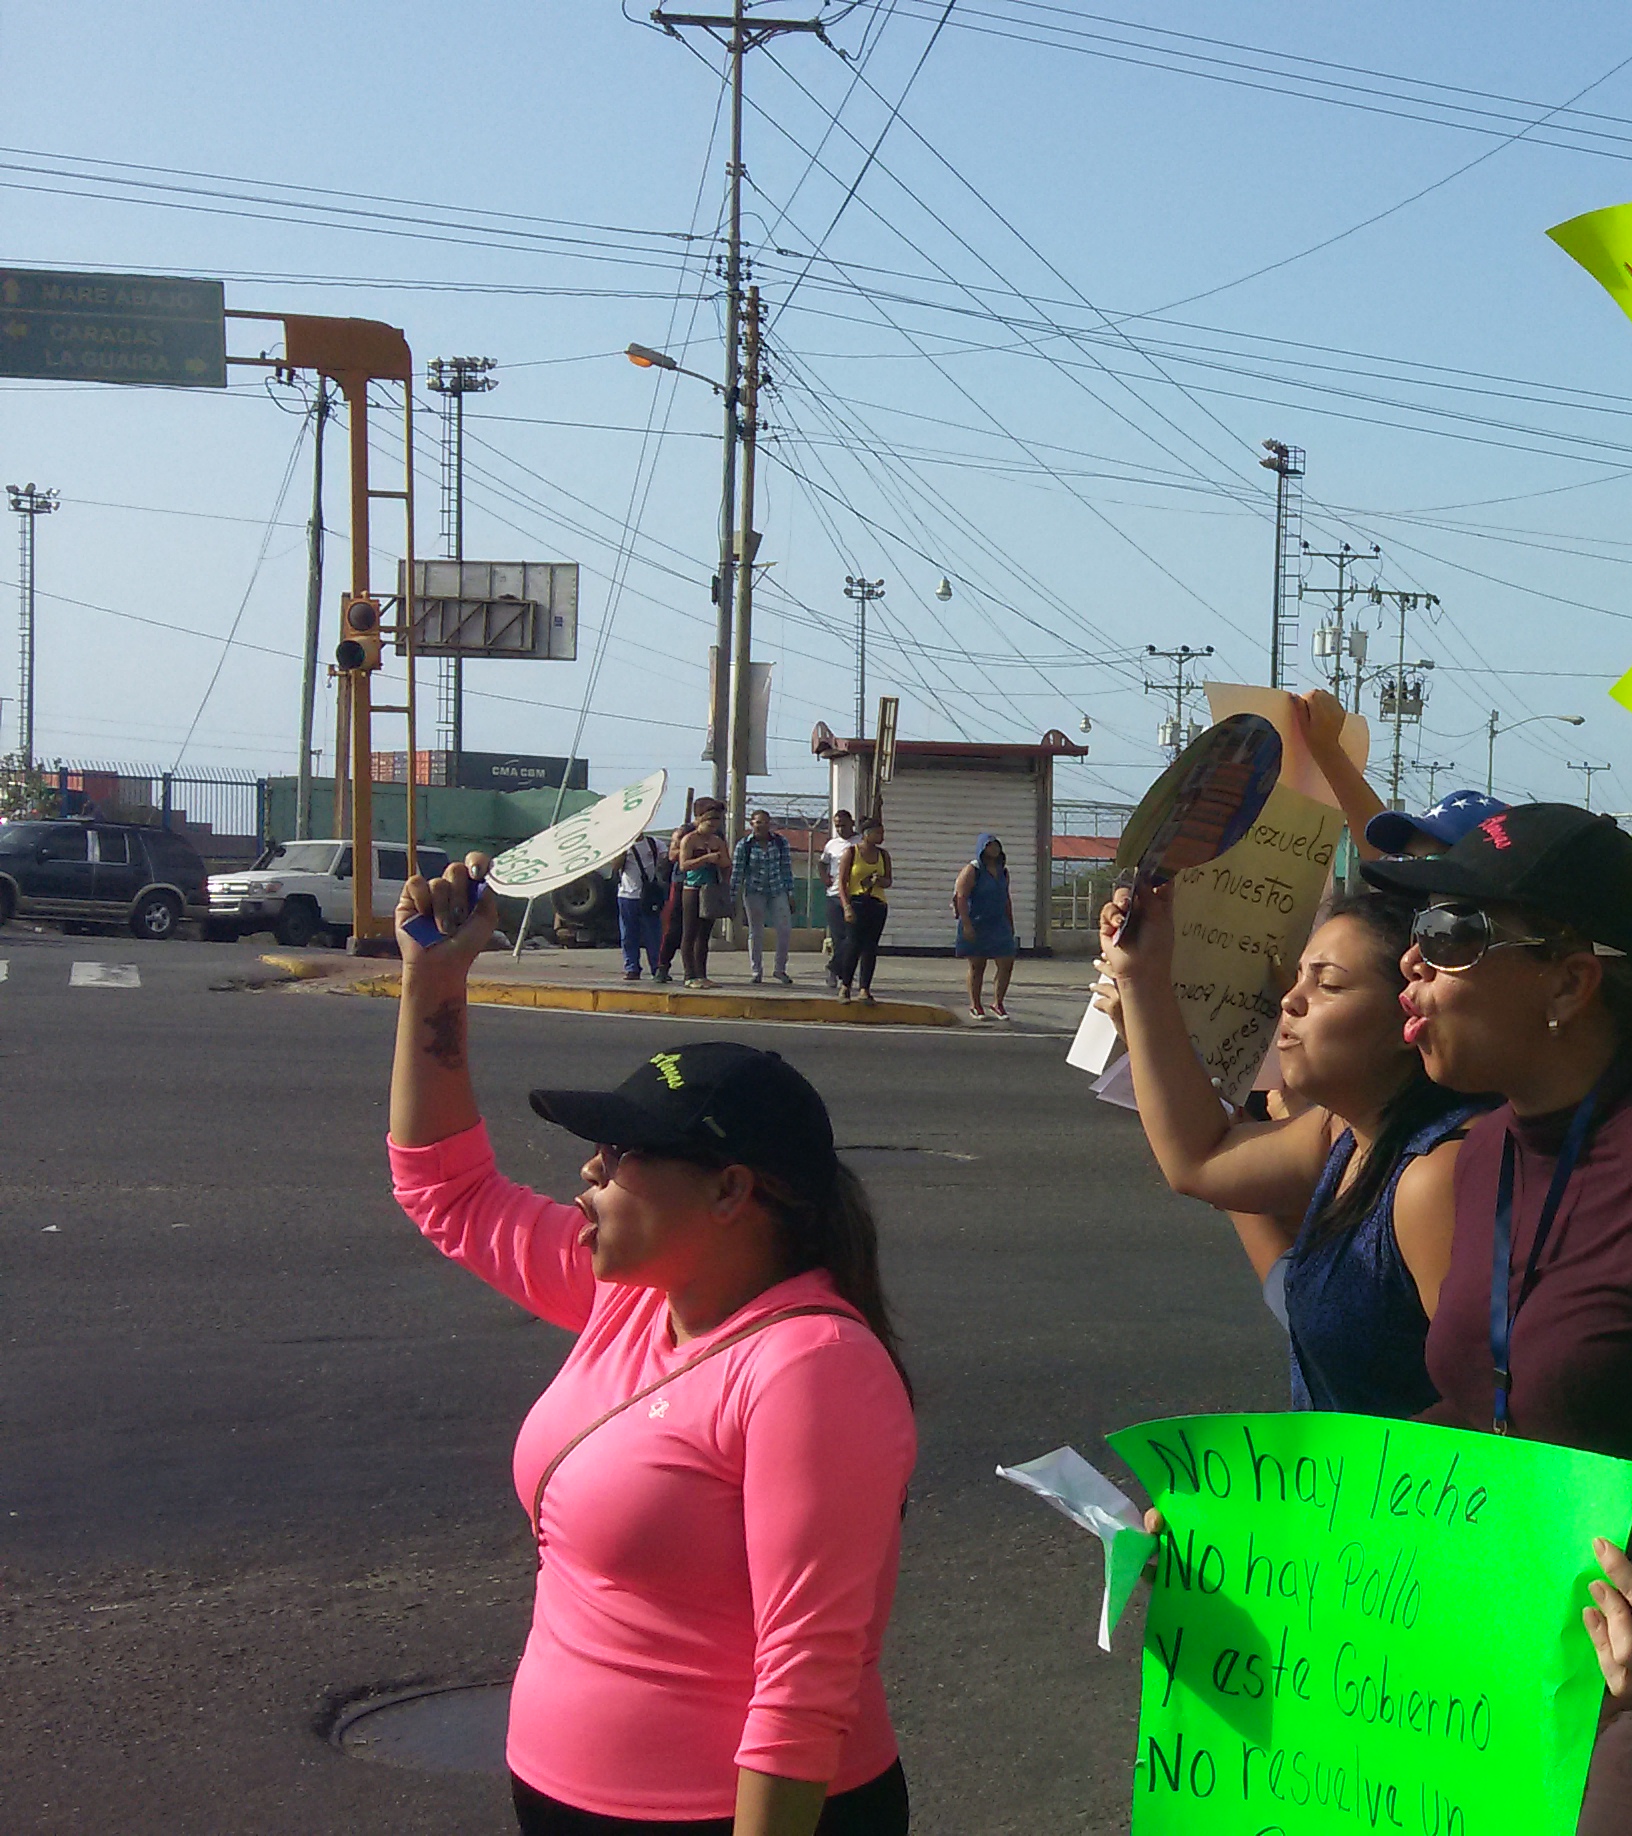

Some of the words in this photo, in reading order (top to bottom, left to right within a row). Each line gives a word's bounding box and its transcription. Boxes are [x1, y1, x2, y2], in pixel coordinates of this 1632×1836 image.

[43, 284, 109, 304] MARE
[115, 288, 194, 308] ABAJO
[46, 349, 77, 367] LA
[81, 350, 170, 371] GUAIRA
[49, 322, 165, 347] CARACAS
[491, 765, 519, 778] CMA
[1147, 1429, 1231, 1499] No
[1243, 1426, 1344, 1533] hay
[1370, 1428, 1488, 1527] leche
[1164, 1528, 1226, 1595] No
[1245, 1531, 1320, 1632] hay
[1212, 1625, 1311, 1700] este
[1333, 1641, 1491, 1752] Gobierno
[1147, 1732, 1216, 1799] No
[1242, 1740, 1404, 1829] resuelve
